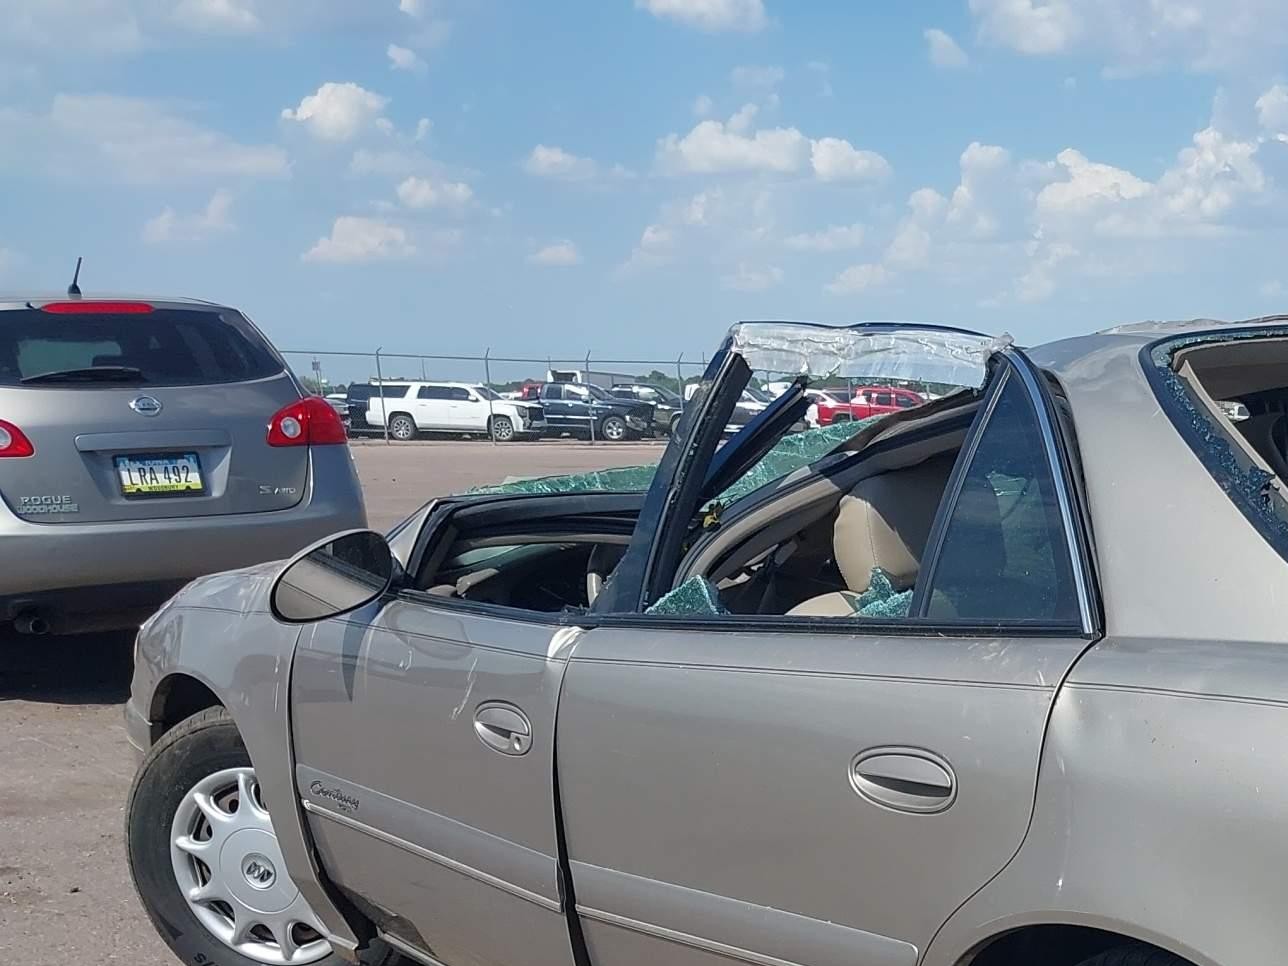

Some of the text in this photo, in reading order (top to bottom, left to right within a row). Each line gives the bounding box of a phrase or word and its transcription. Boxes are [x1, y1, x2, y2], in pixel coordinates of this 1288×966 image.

[127, 465, 192, 486] LRA 492
[20, 495, 72, 505] ROGUE
